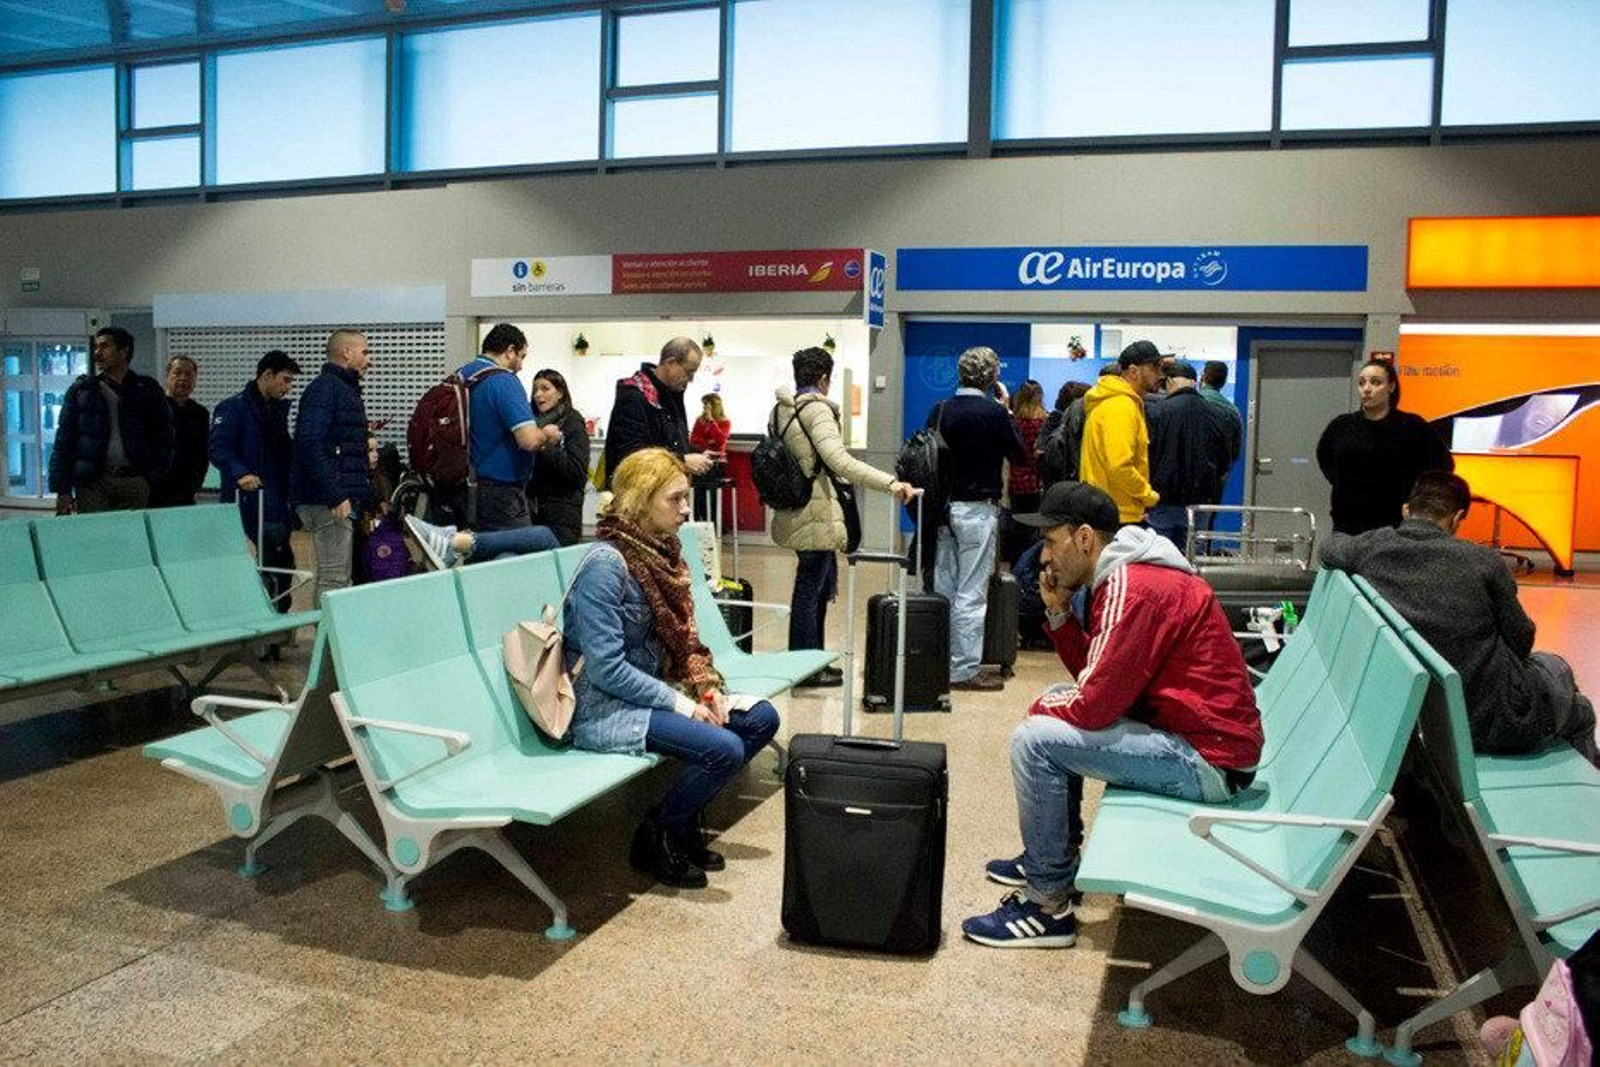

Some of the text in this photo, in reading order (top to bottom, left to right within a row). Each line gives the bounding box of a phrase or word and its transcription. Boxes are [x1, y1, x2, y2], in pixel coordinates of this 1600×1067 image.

[748, 263, 809, 277] IBERIA
[1066, 257, 1186, 283] AirEuropa
[512, 282, 566, 292] sin barreras
